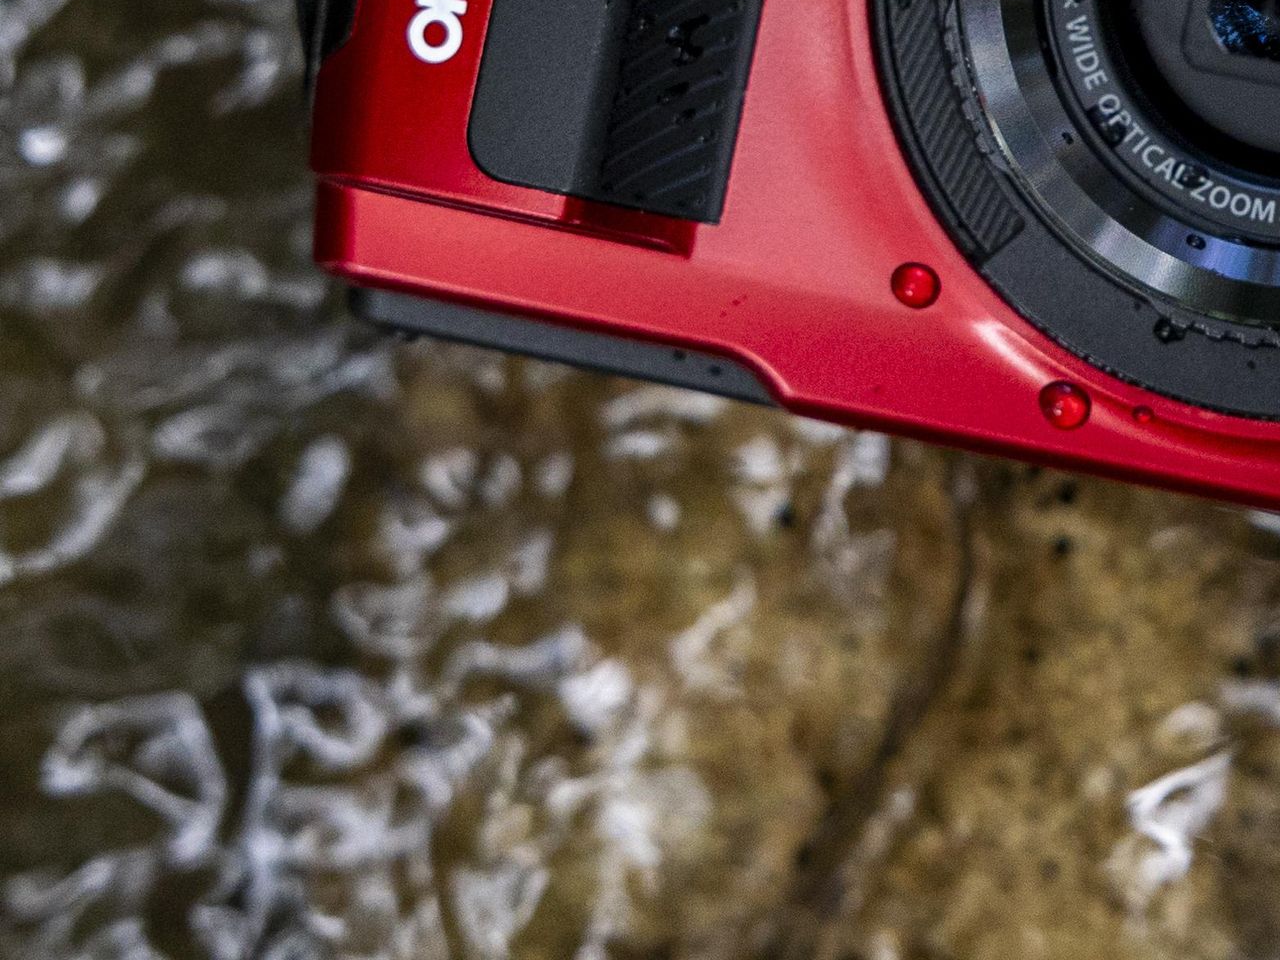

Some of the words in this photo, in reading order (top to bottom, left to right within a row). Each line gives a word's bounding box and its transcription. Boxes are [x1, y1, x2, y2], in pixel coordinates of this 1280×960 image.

[1064, 14, 1108, 90] WIDE
[1098, 94, 1188, 189] OPTICAL
[1190, 177, 1276, 225] ZOOM
